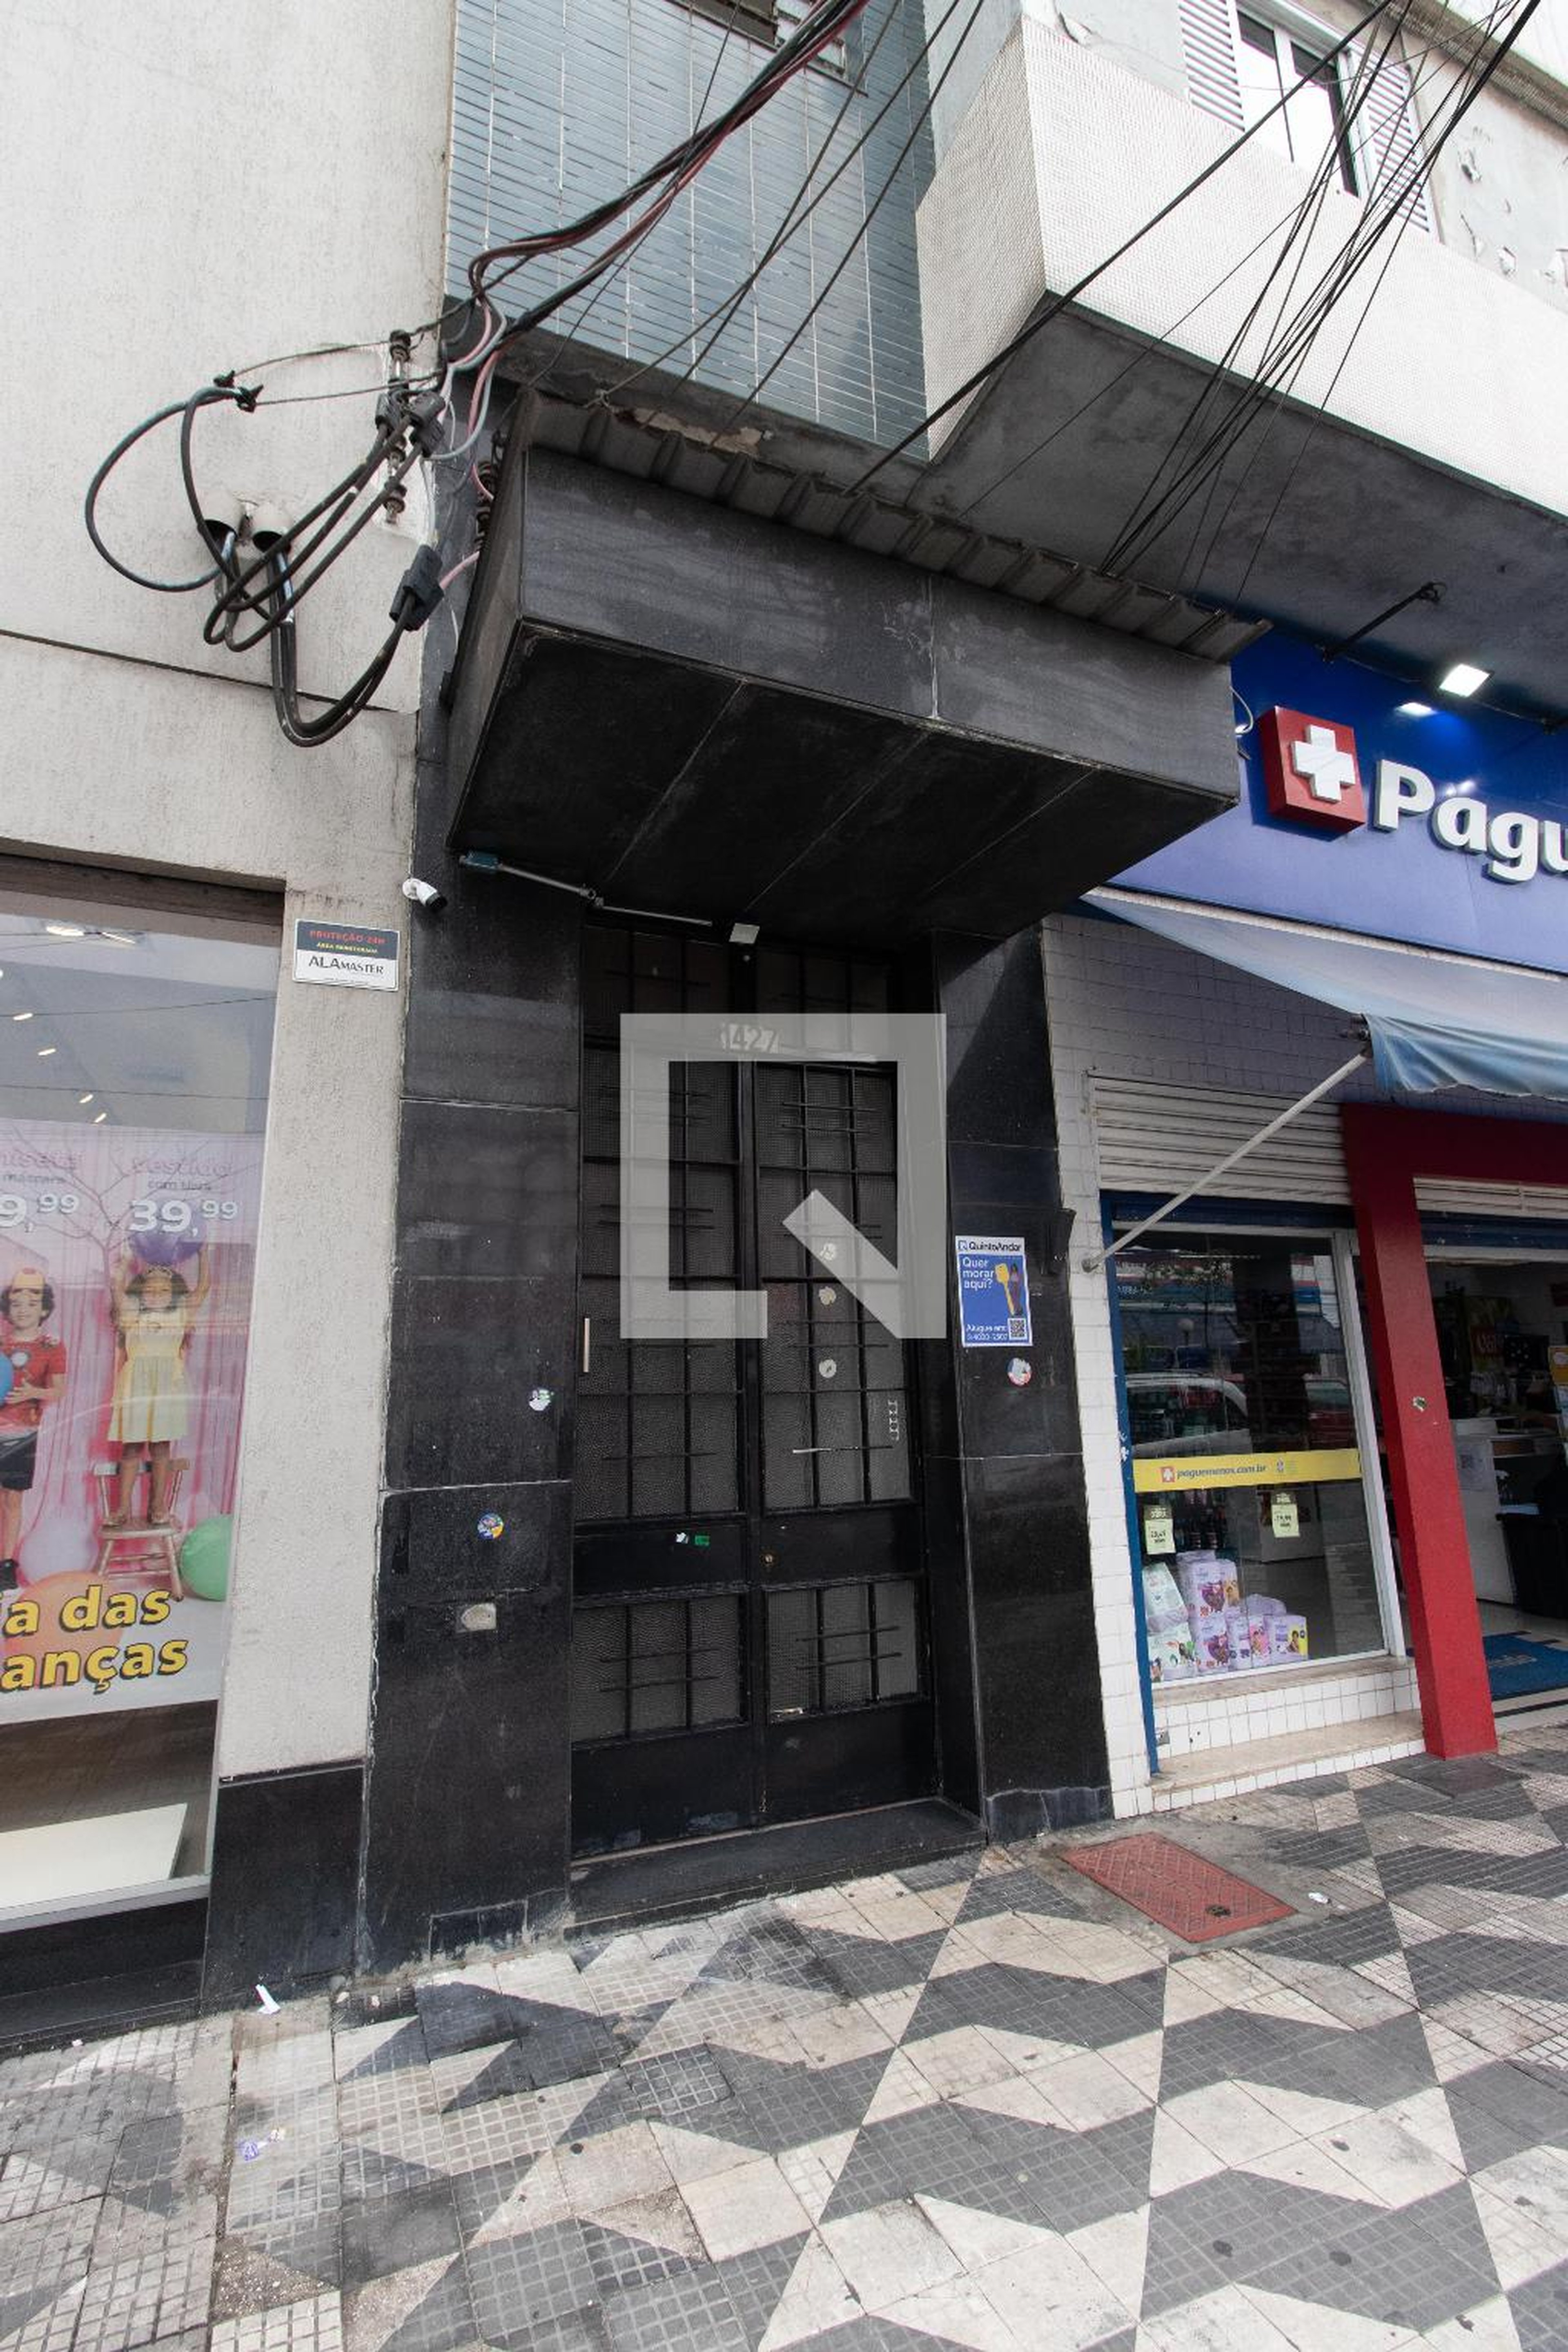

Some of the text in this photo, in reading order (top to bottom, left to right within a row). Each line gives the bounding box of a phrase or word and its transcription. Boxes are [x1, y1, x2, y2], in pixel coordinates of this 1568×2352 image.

[962, 1256, 989, 1267] Quer
[964, 1278, 993, 1291] aqui?
[59, 1584, 171, 1633] das
[0, 1639, 189, 1695] anças
